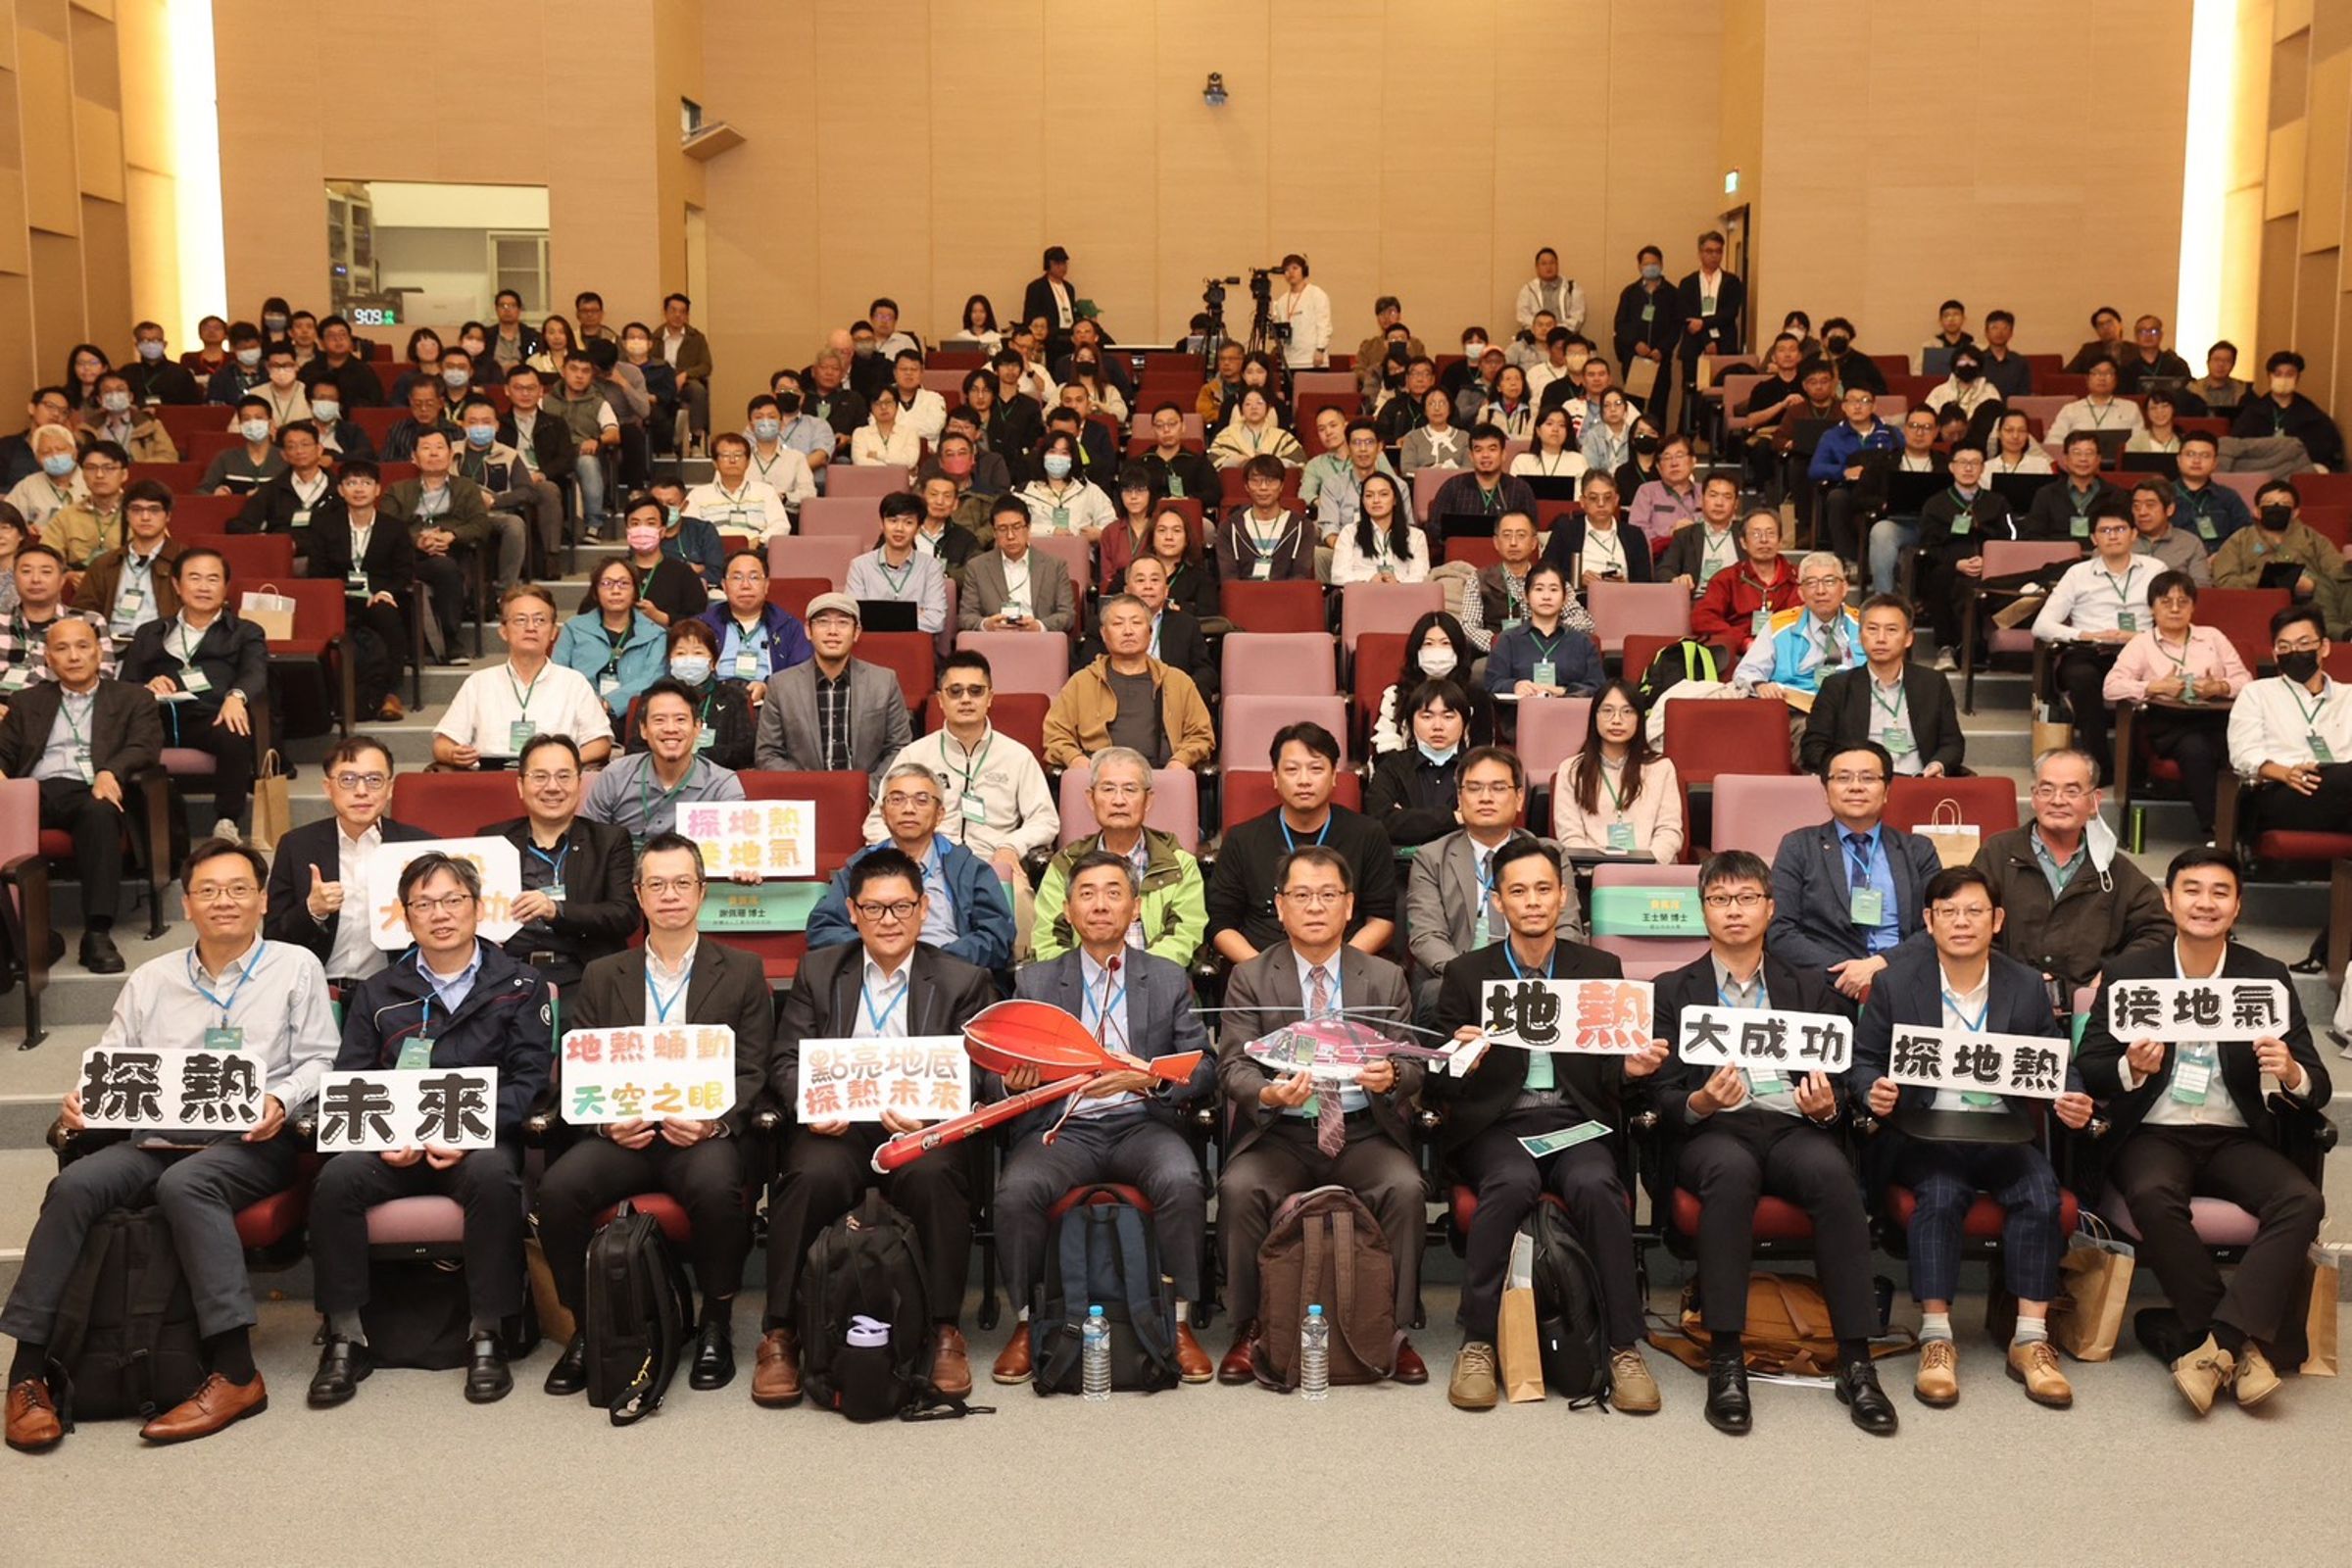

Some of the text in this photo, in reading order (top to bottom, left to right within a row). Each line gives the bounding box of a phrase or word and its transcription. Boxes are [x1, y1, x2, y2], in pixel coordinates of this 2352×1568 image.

[688, 807, 801, 837] 探地熱
[1485, 981, 1651, 1049] 地熱
[2114, 985, 2282, 1031] 接地氣
[566, 1029, 730, 1063] 地熱蛹動
[1685, 1013, 1845, 1064] 大成功
[808, 1043, 959, 1084] 點亮地底
[1893, 1034, 2062, 1092] 探地熱
[81, 1051, 261, 1123] 探熱
[320, 1073, 491, 1145] 未來
[572, 1081, 724, 1116] 天空之眼
[805, 1078, 962, 1115] 探熱未來
